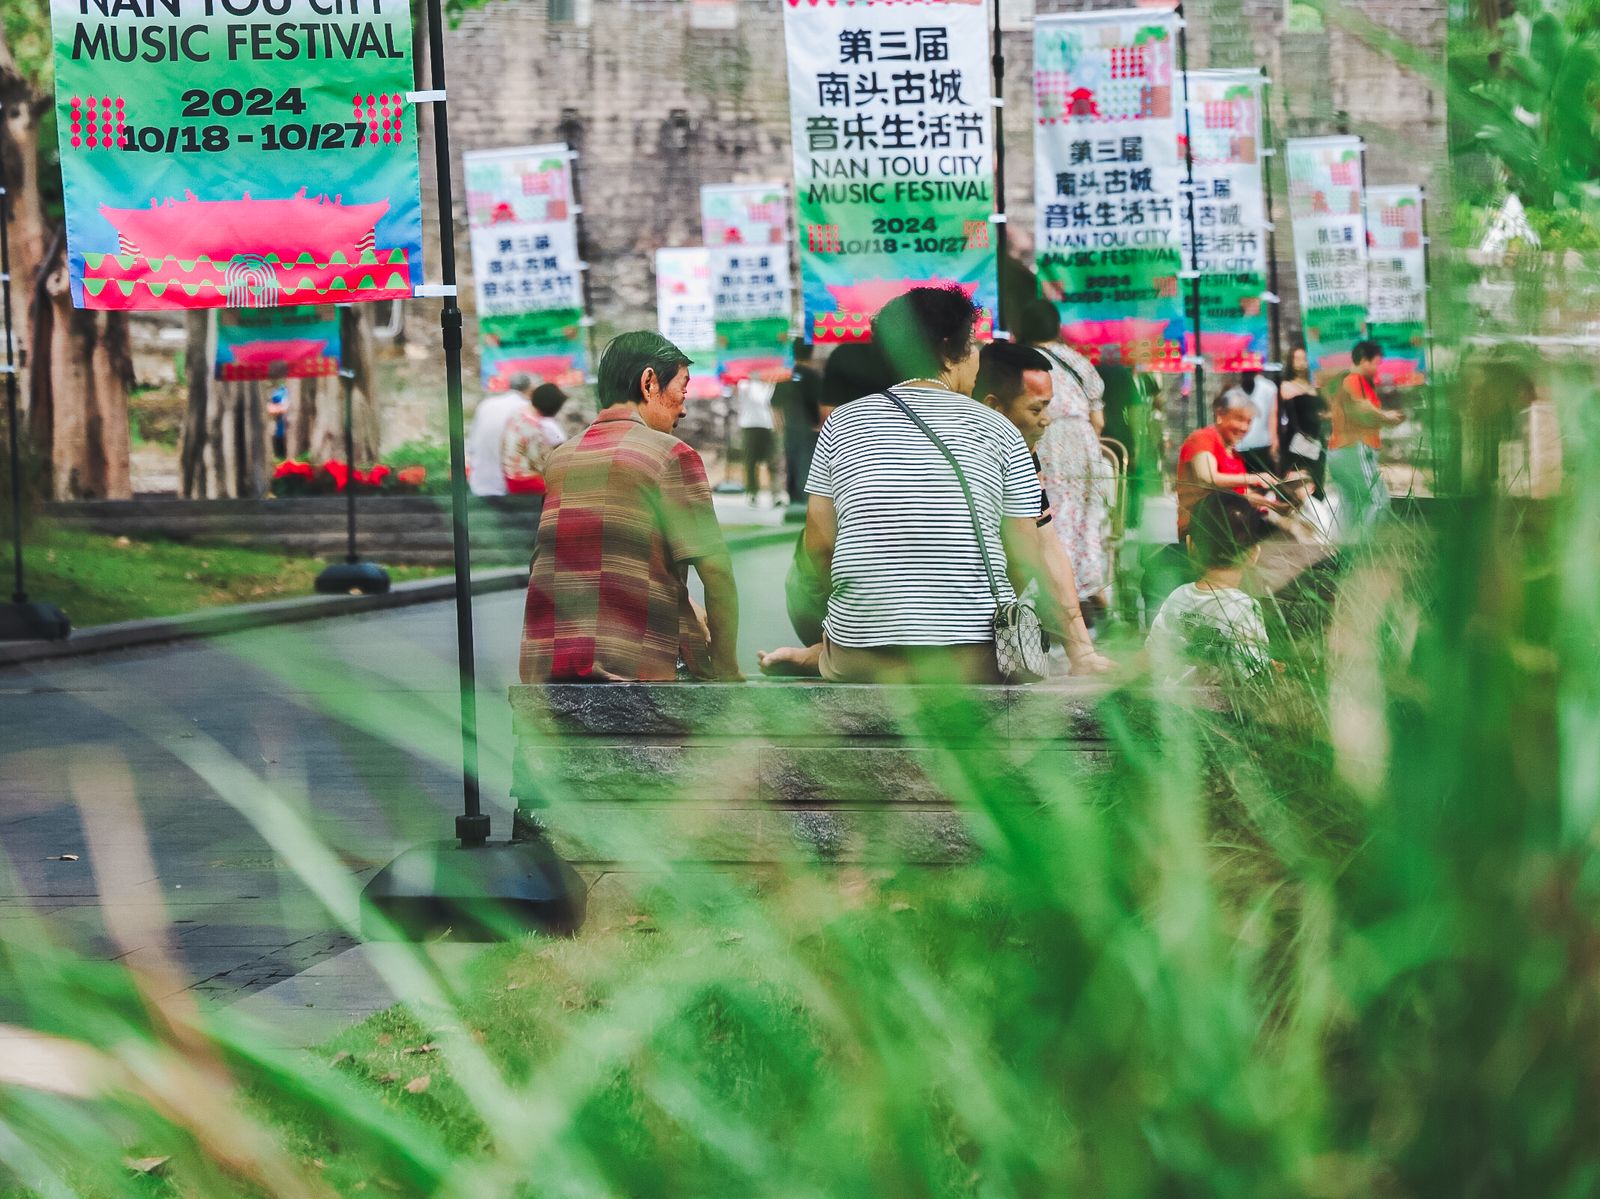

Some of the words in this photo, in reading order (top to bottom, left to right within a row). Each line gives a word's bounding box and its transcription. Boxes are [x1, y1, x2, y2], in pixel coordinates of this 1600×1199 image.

[71, 22, 211, 63] MUSIC
[228, 22, 404, 61] FESTIVAL
[838, 26, 949, 64] 第三届
[181, 86, 307, 118] 2024
[816, 68, 973, 108] 南头古城
[806, 110, 984, 152] 音乐生活节
[1070, 136, 1143, 166] 第三届
[811, 157, 869, 179] NAN
[879, 156, 929, 178] TOU
[939, 155, 982, 176] CITY
[807, 182, 886, 205] MUSIC
[895, 180, 989, 202] FESTIVAL
[872, 217, 938, 235] 2024
[1093, 231, 1128, 248] TOU
[1134, 229, 1171, 245] CITY
